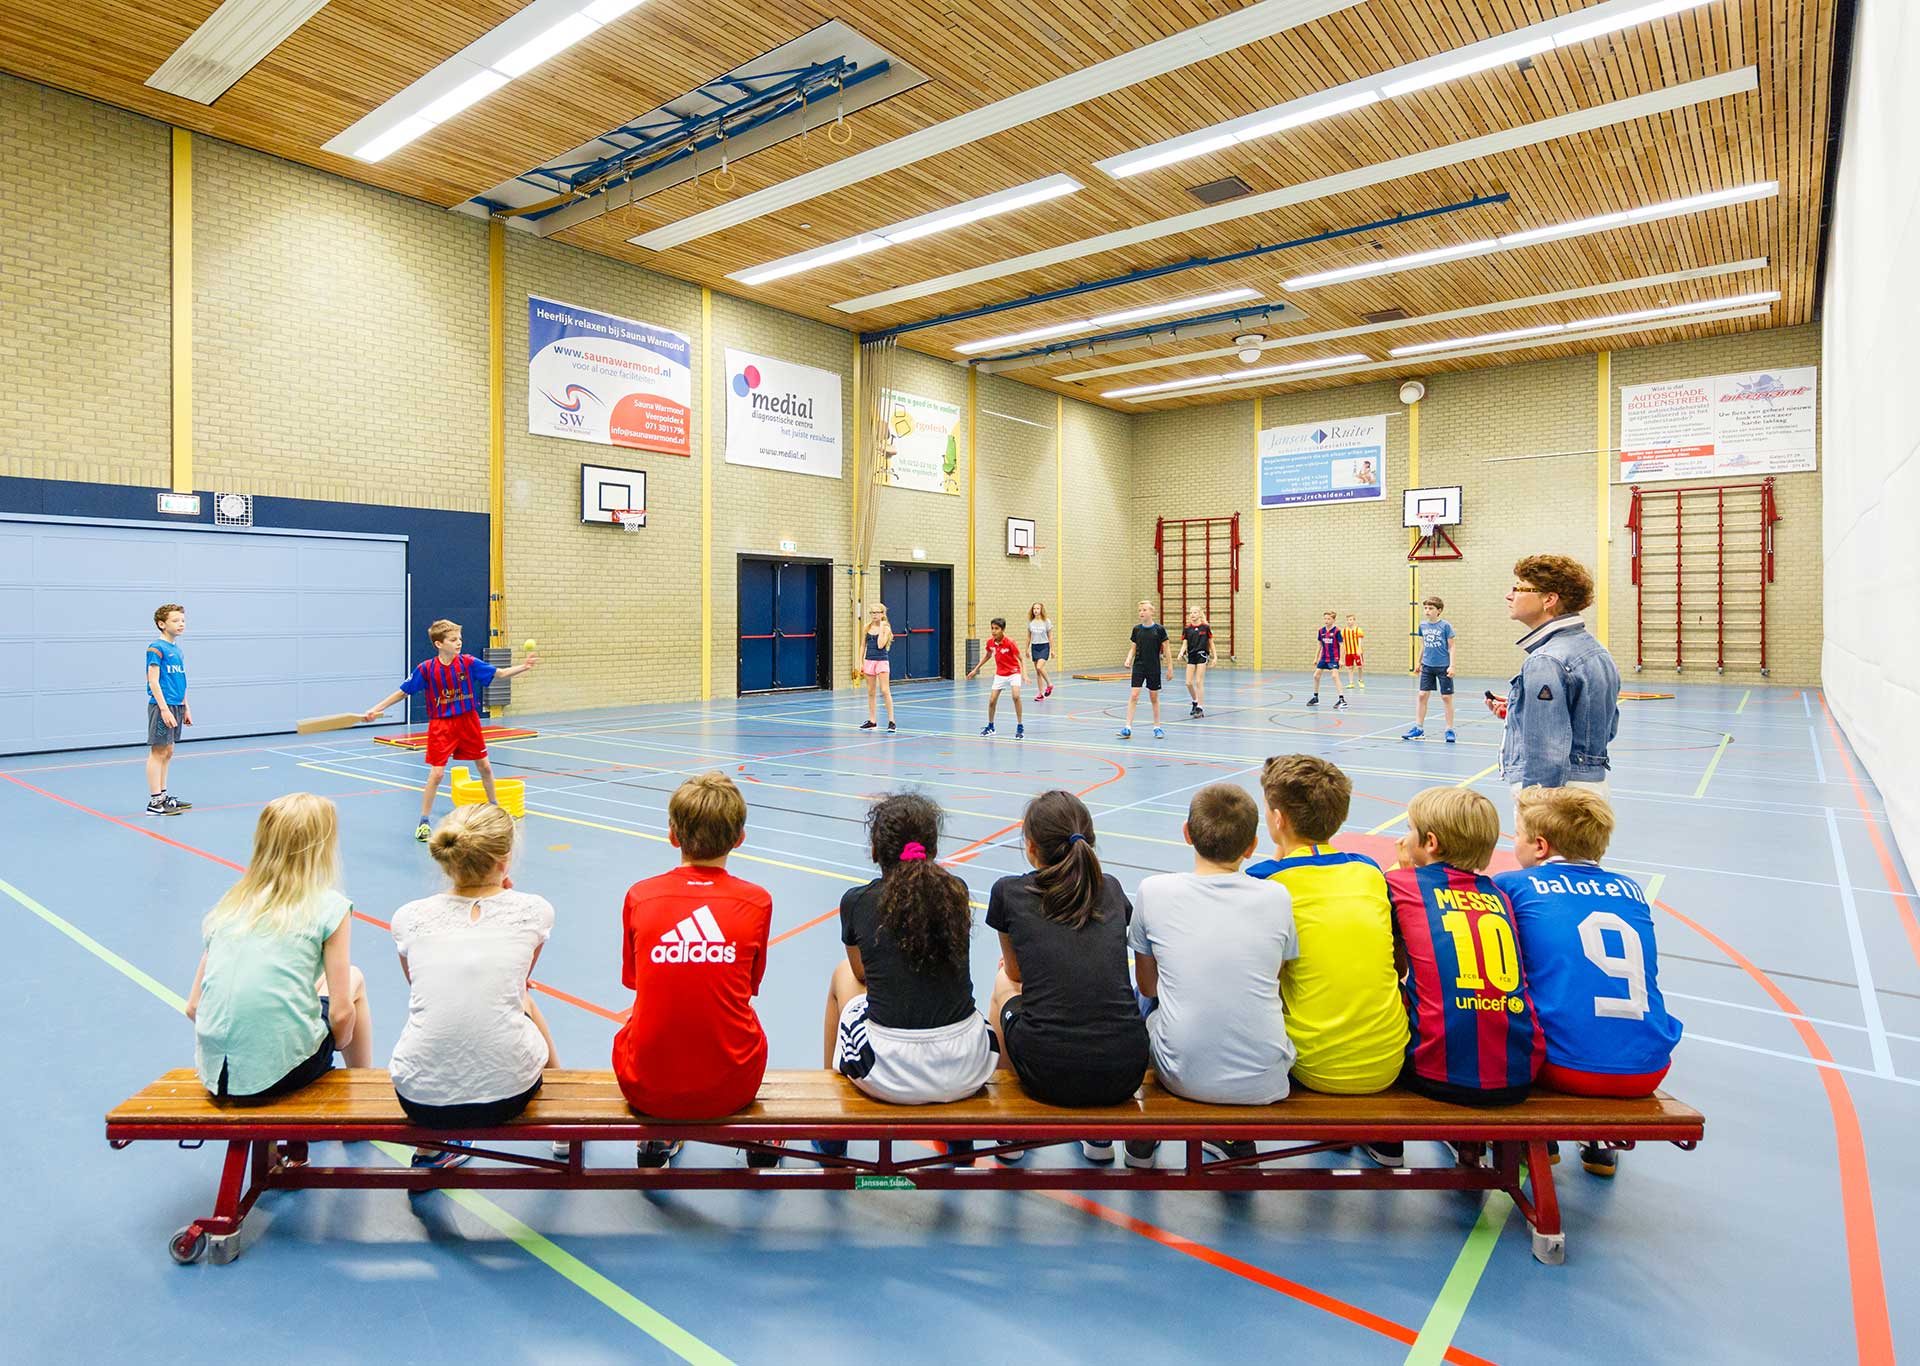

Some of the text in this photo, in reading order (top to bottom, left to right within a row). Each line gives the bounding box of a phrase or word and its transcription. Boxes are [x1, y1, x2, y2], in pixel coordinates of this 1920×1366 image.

[537, 308, 685, 352] Heerlijk relaxen bij Sauna Warmond
[554, 345, 672, 378] www.saunawarmond.nl
[572, 362, 656, 385] voor al onze faciliteiten
[752, 392, 813, 419] medial
[1628, 395, 1709, 410] BOLLENSTREEK
[1632, 388, 1704, 402] AUTOSCHADE
[634, 399, 684, 416] Sauna Warmond
[560, 412, 585, 427] SW
[752, 411, 814, 429] diagnostische centra
[792, 429, 809, 439] juiste
[810, 434, 835, 444] resultaat
[1269, 424, 1374, 449] Jansen Ruiter
[759, 447, 807, 461] www.medial.nl
[1528, 874, 1646, 905] balotelli
[1434, 888, 1506, 915] MESSI
[651, 940, 736, 963] adidas
[1441, 911, 1520, 993] 10
[1577, 911, 1650, 1021] 9
[1456, 993, 1507, 1012] unicef
